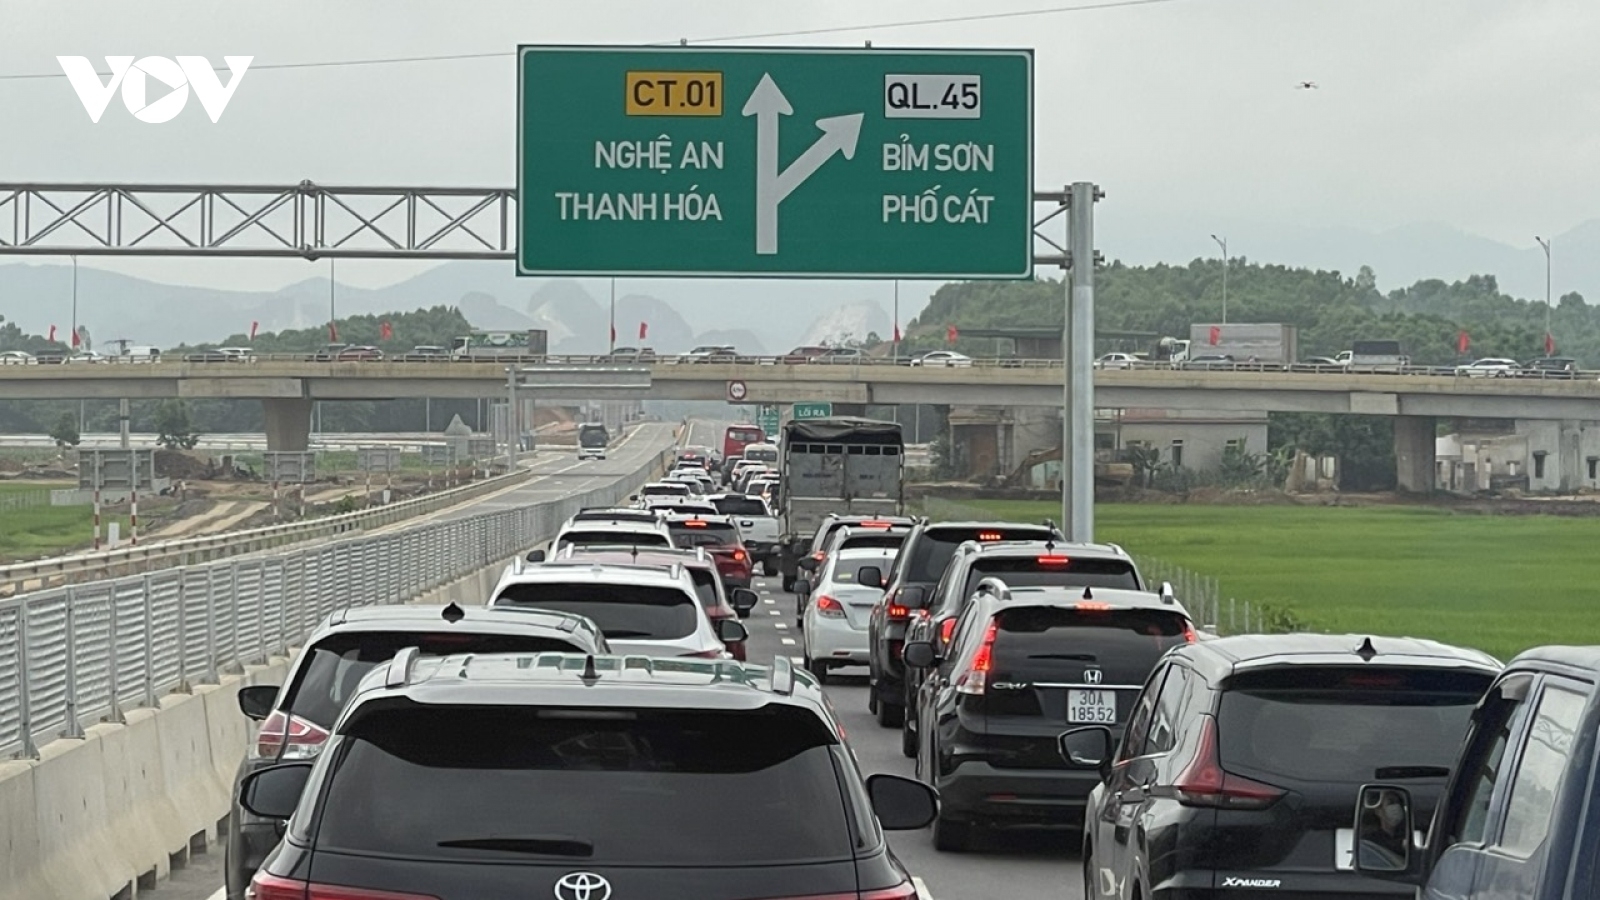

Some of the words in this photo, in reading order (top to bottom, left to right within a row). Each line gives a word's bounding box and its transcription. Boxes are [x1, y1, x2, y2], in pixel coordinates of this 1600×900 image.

[633, 80, 715, 108] CT.01
[887, 82, 978, 110] QL.45
[595, 133, 672, 174] NGHỆ
[679, 141, 724, 169] AN
[883, 133, 929, 171] BỈM
[934, 141, 994, 171] SƠN
[555, 192, 657, 221] THANH
[664, 184, 723, 221] HÓA
[883, 184, 941, 223] PHỐ
[943, 188, 995, 223] CÁT
[813, 409, 826, 417] RA
[1079, 690, 1105, 706] 30A
[1222, 876, 1281, 888] XPANDER
